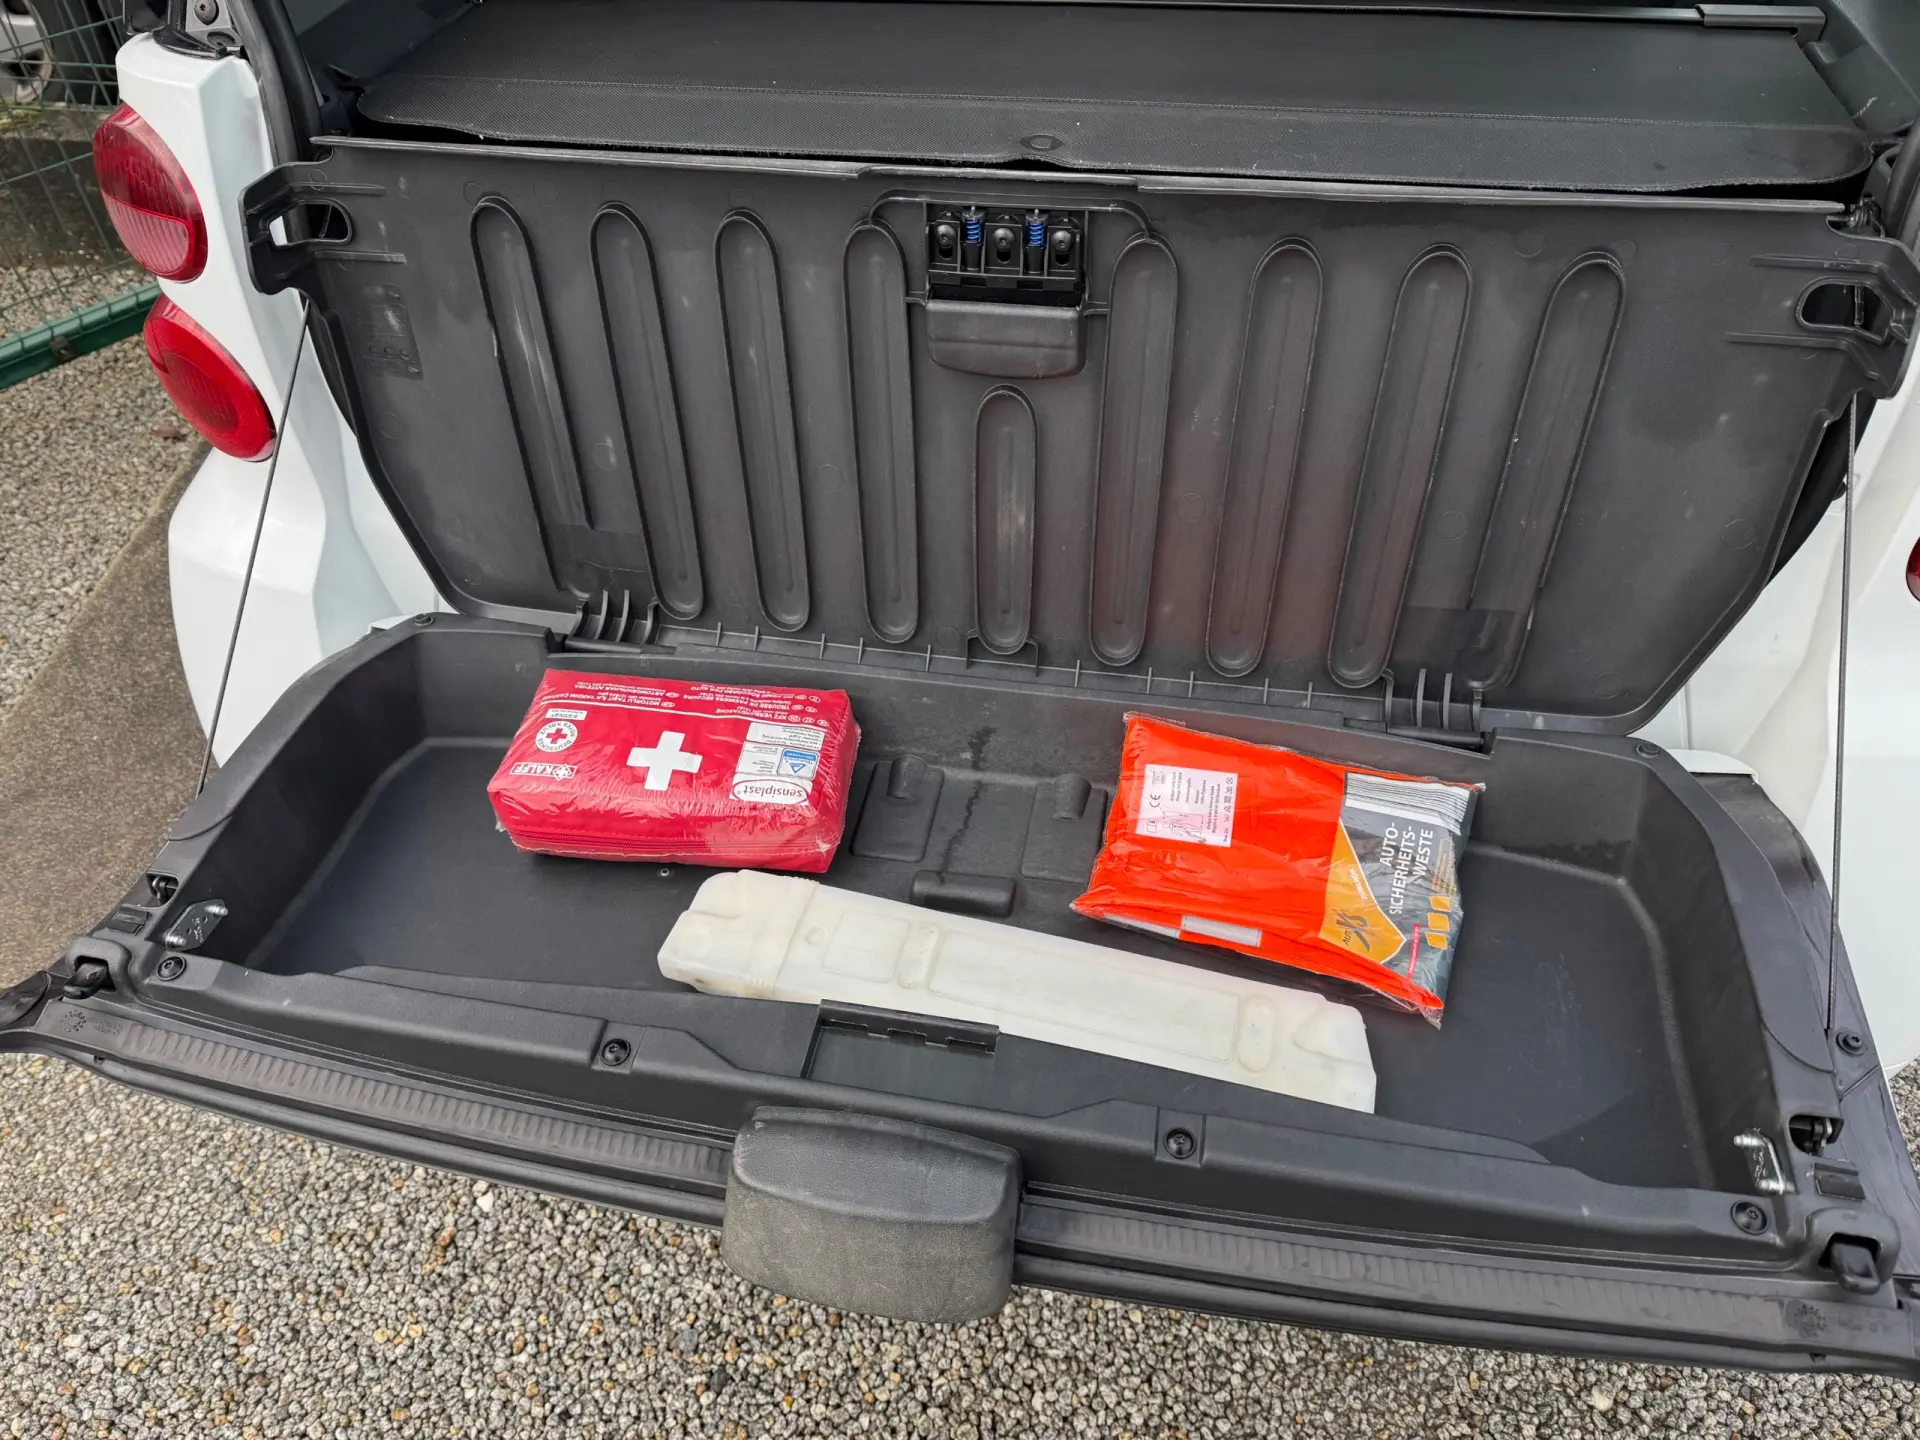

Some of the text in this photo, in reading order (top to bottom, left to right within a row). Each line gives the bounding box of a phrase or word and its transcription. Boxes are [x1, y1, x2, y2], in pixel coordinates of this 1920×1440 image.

[514, 764, 553, 774] KALFF
[1380, 822, 1398, 867] AUTO-
[1412, 828, 1434, 876] WESTE
[1389, 826, 1416, 914] SICHERHEITS-
